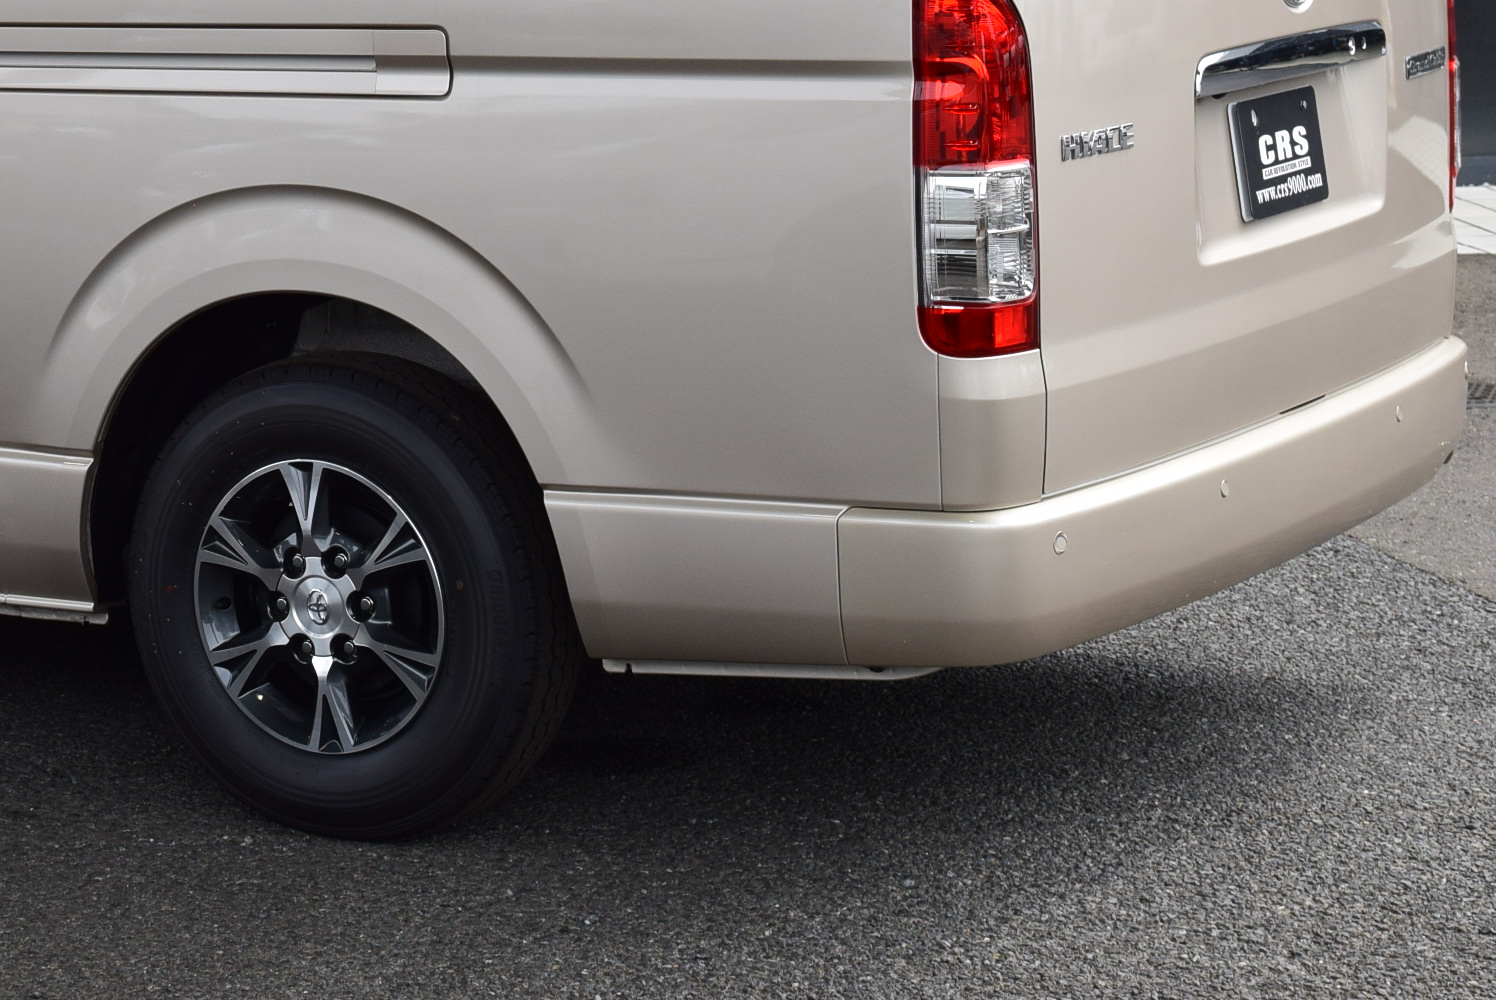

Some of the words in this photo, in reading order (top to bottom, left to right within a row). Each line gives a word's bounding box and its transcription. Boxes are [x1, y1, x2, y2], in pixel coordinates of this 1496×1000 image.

[1259, 125, 1309, 165] CRS
[1264, 168, 1273, 177] CAR
[1273, 162, 1297, 175] REVOLUTION
[1297, 158, 1310, 169] STYLE
[1256, 172, 1323, 204] www.crs9000.com
